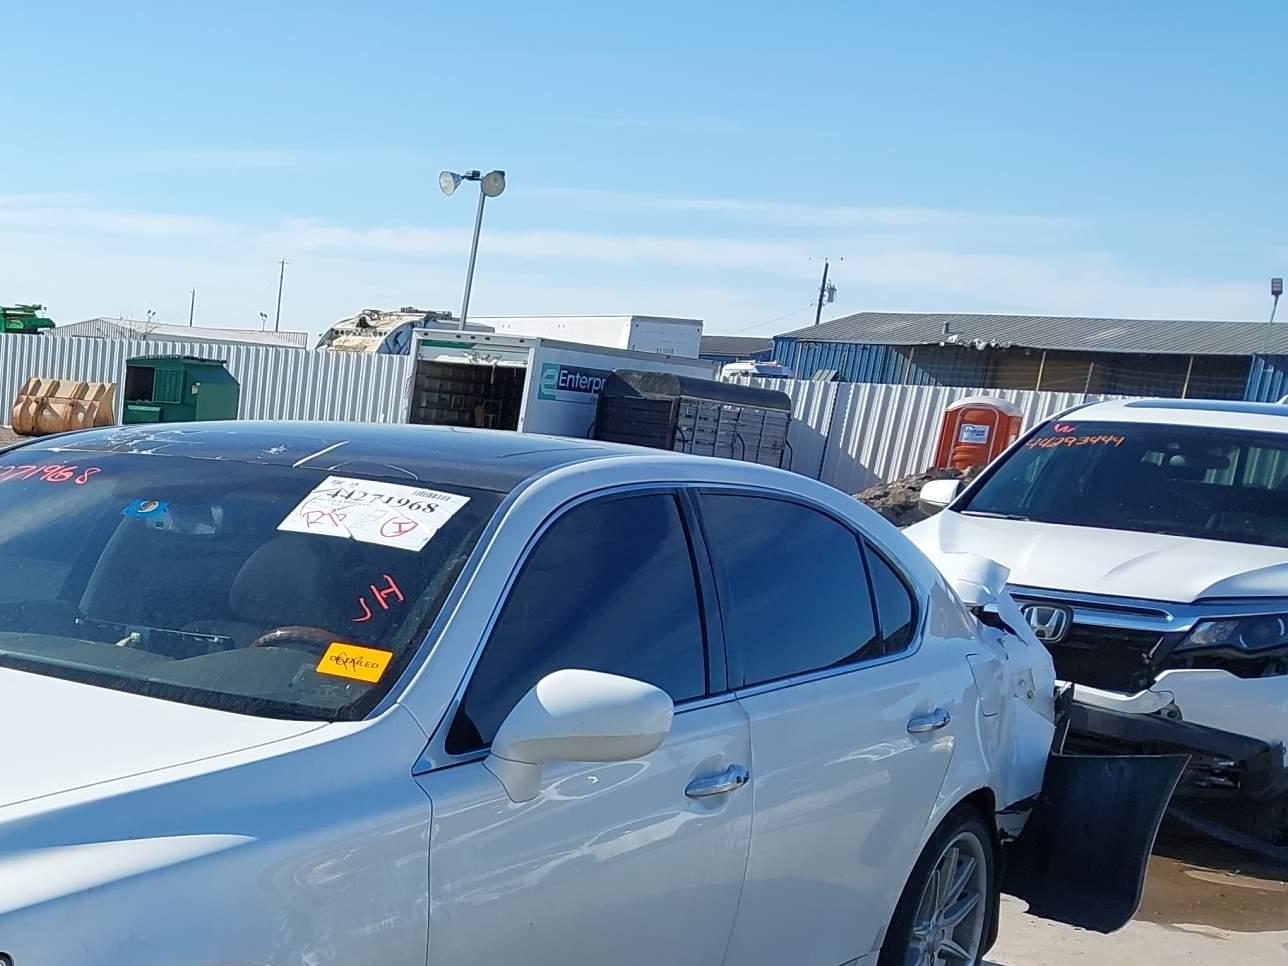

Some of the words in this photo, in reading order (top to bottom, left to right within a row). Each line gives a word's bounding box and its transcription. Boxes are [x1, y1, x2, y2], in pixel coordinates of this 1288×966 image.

[558, 370, 607, 393] Enterpr
[1025, 434, 1126, 448] 44293444
[325, 486, 440, 514] 44271968
